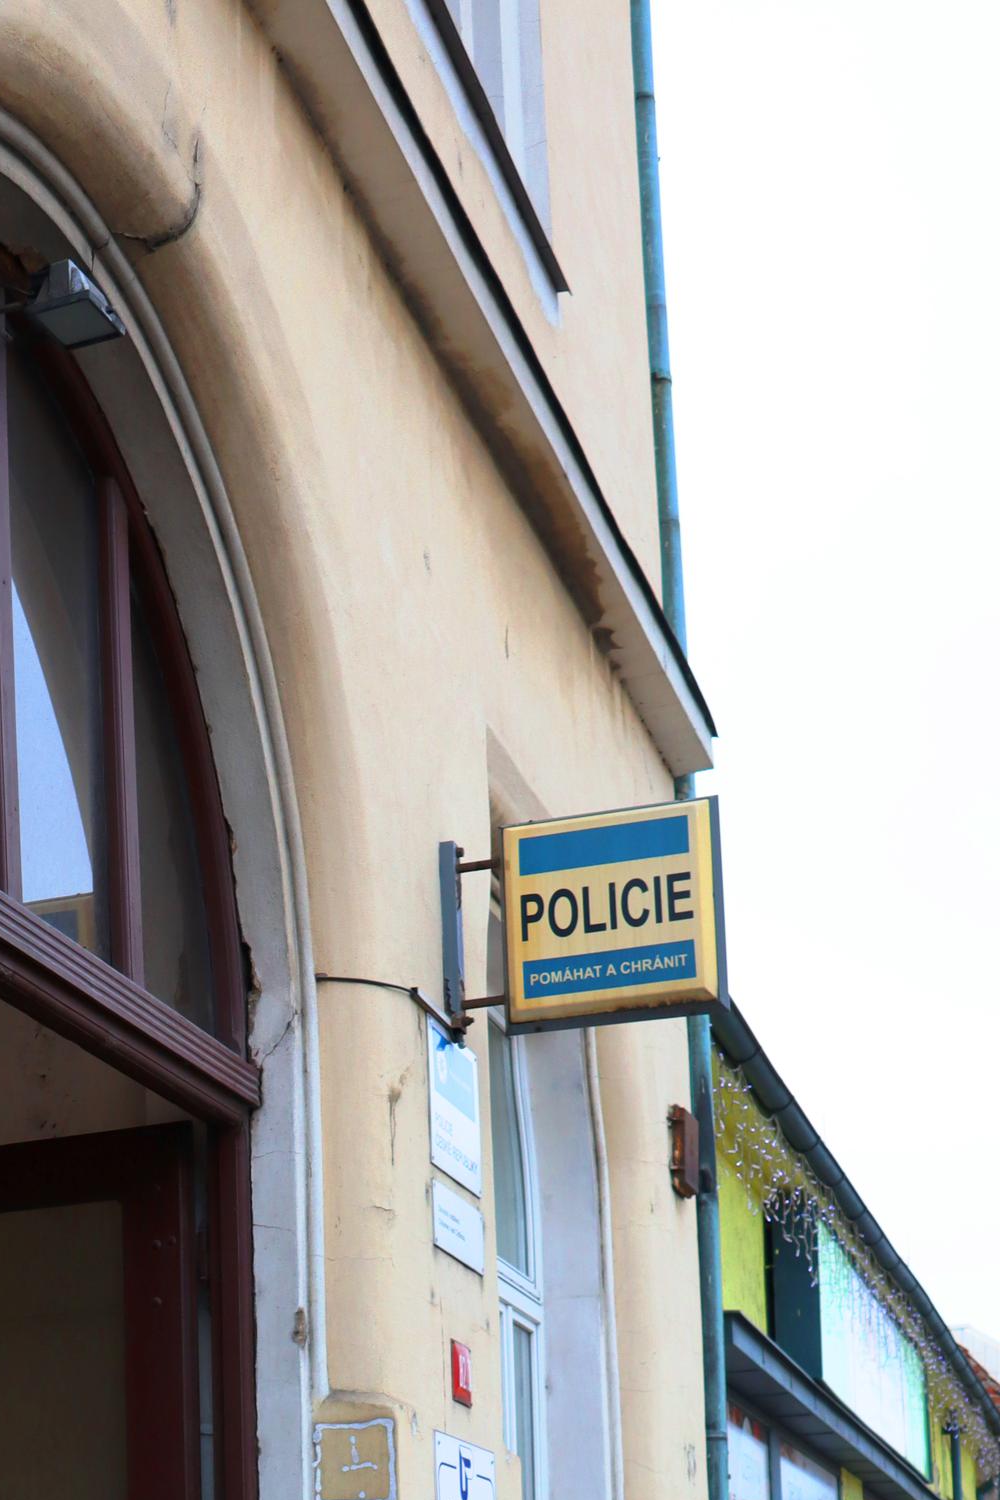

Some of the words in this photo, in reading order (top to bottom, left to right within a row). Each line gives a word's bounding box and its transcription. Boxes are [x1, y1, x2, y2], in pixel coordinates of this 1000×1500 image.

[520, 871, 694, 942] POLICIE
[530, 964, 602, 986] POMÁHAT
[606, 963, 617, 976] A
[620, 953, 688, 974] CHRÁNIT
